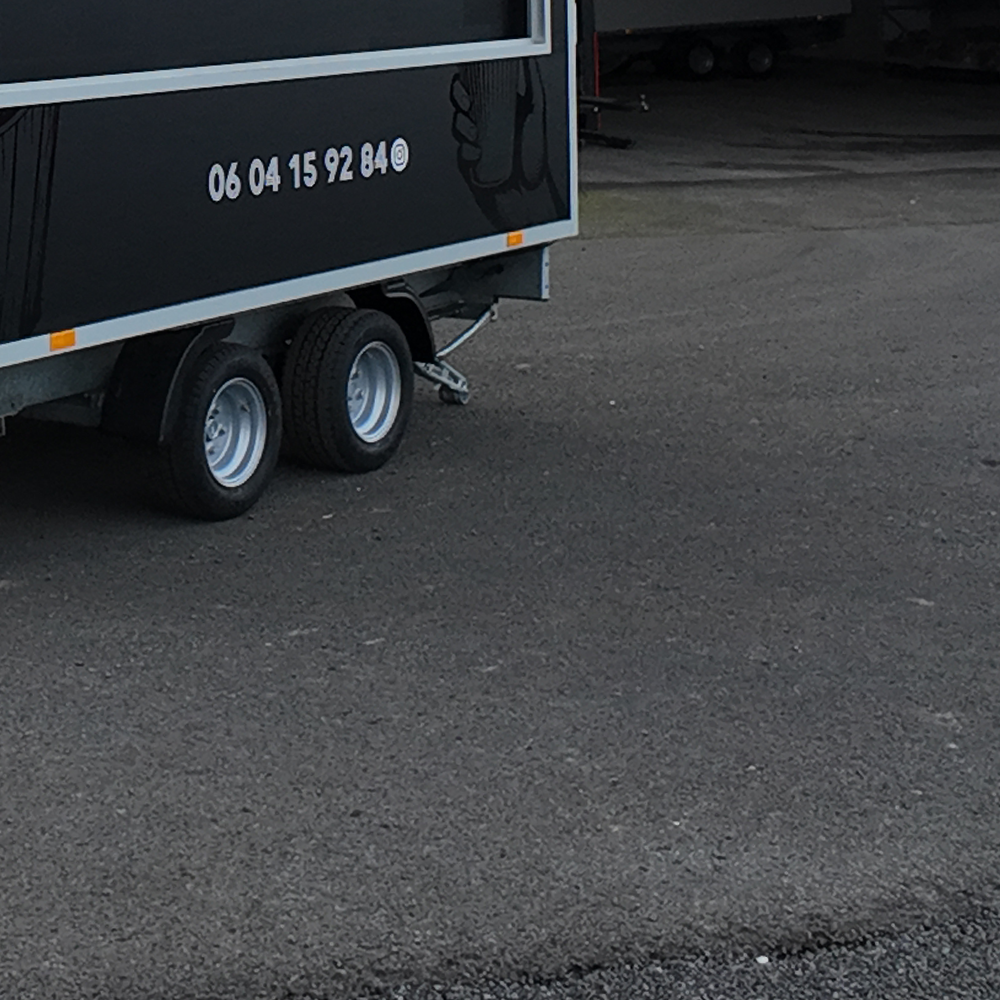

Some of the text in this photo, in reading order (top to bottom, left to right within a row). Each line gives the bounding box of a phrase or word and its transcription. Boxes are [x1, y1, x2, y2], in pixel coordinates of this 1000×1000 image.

[208, 140, 388, 202] 06 04 15 92 84
